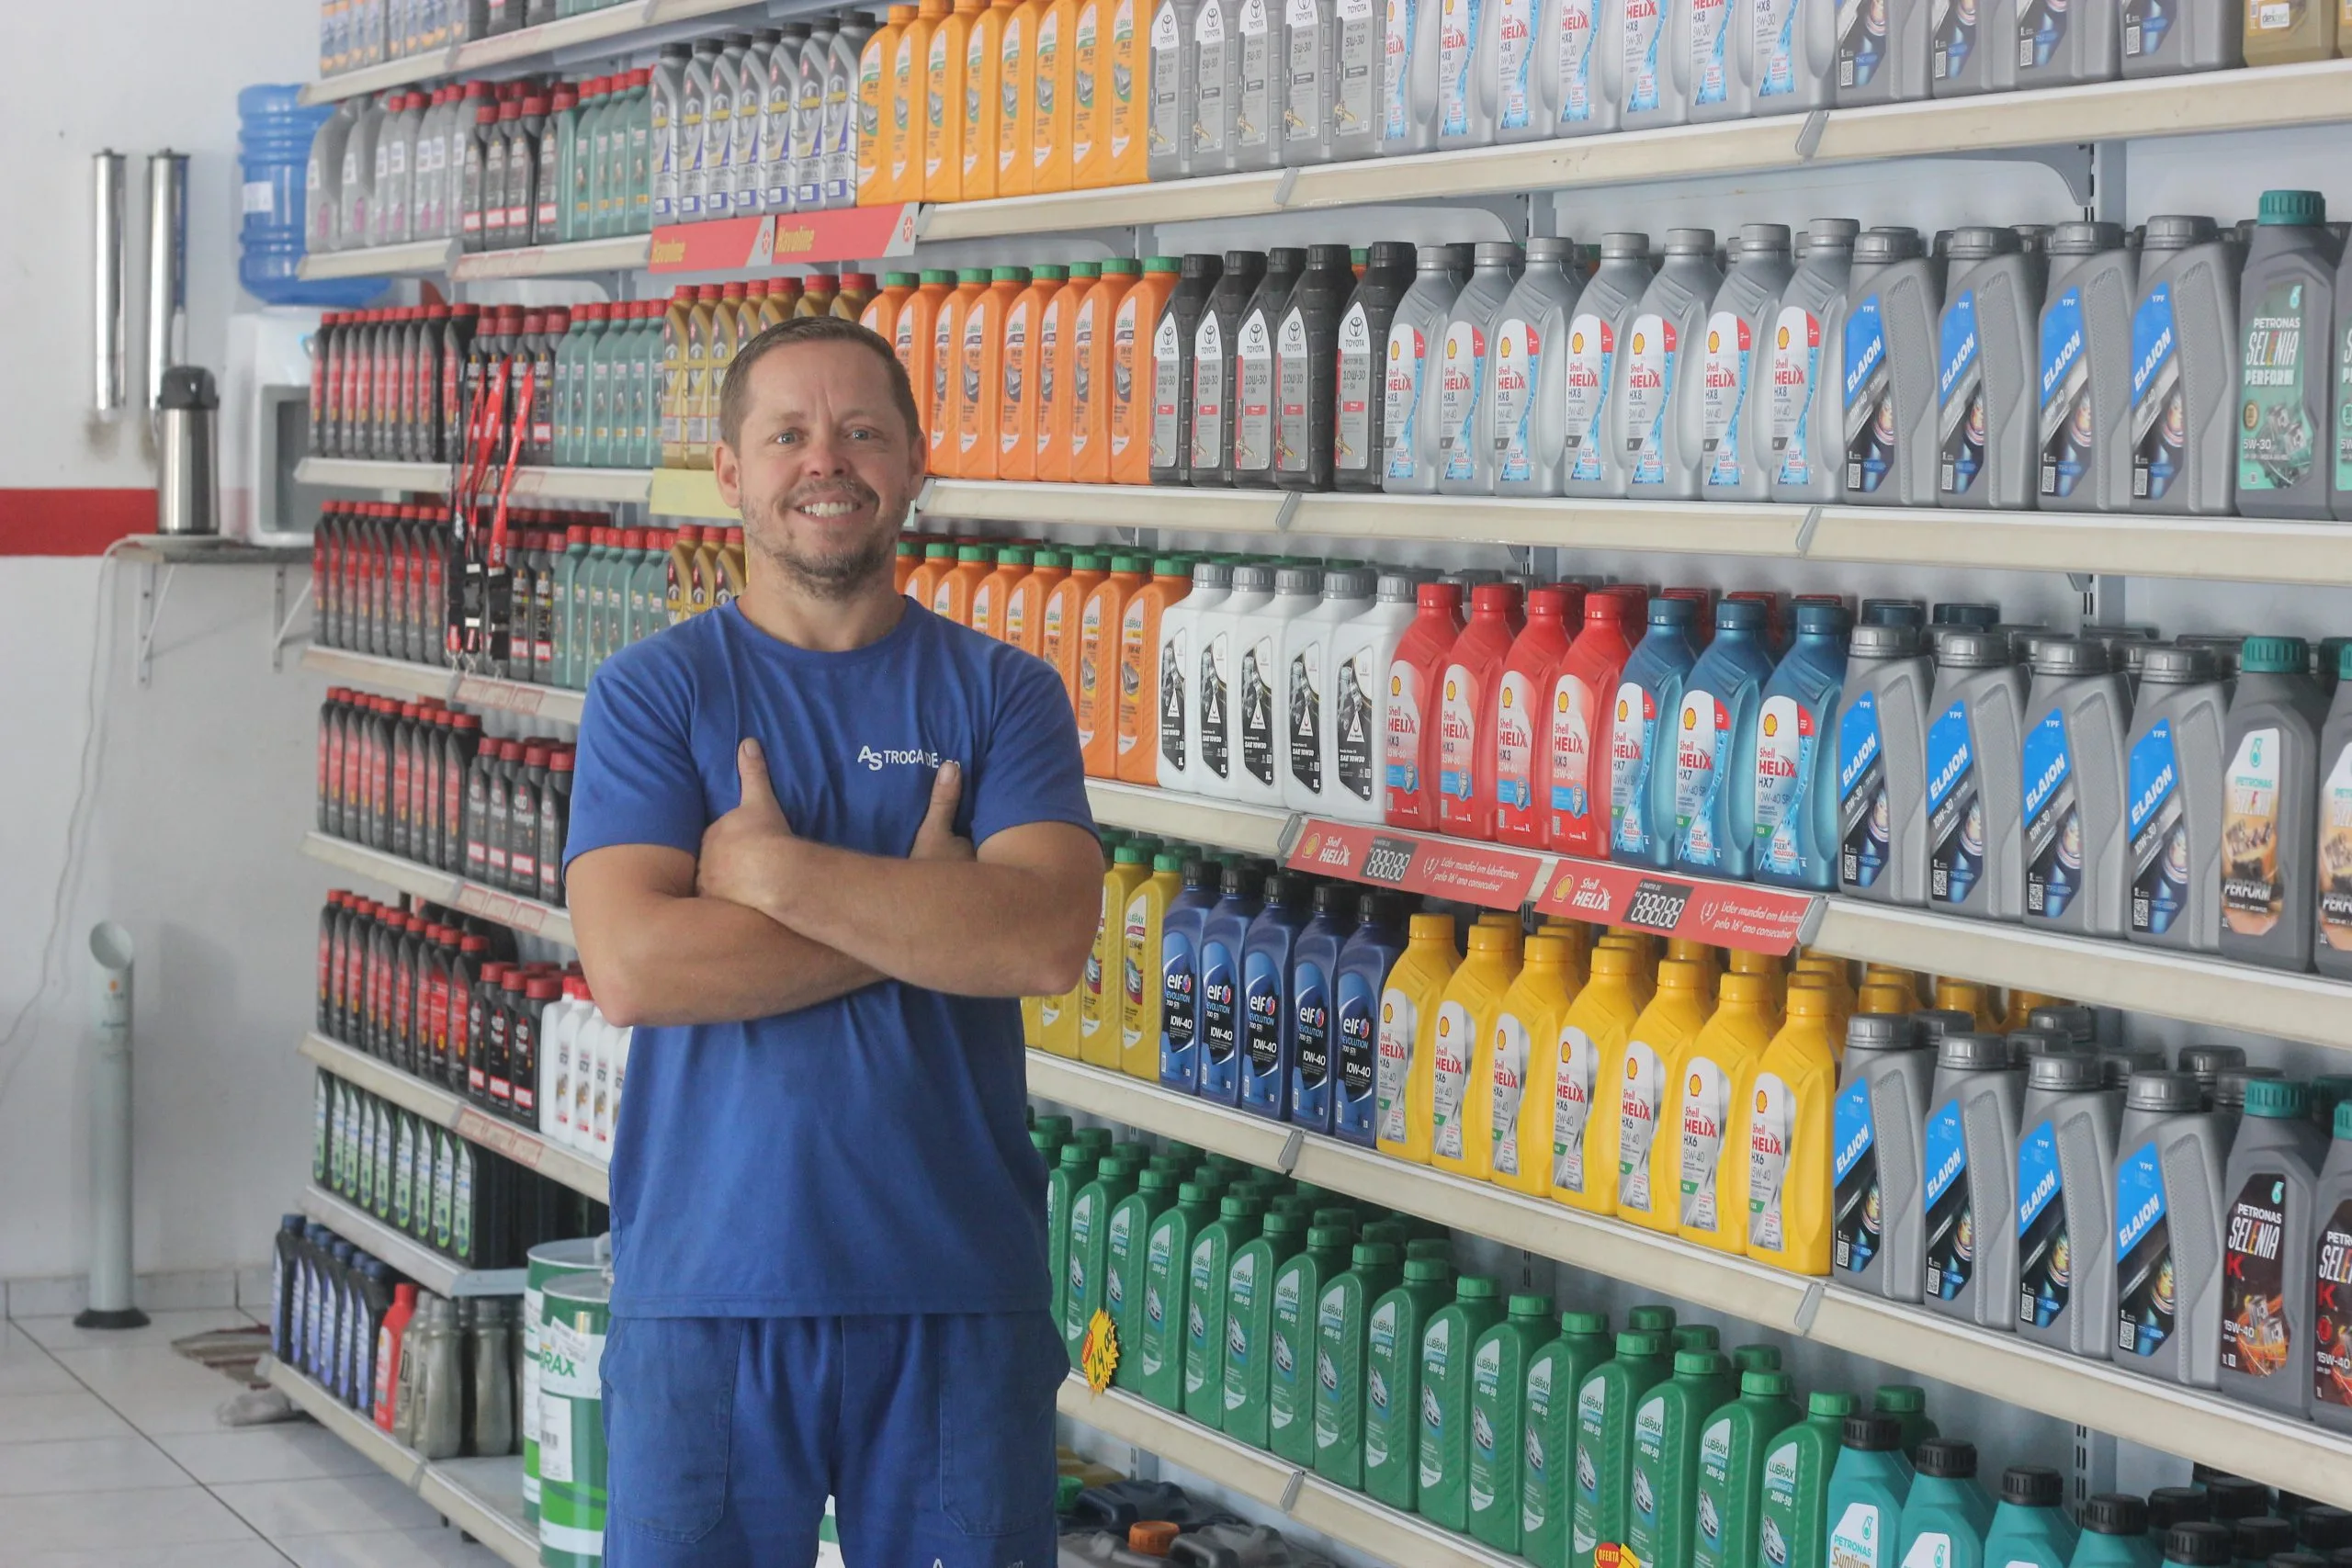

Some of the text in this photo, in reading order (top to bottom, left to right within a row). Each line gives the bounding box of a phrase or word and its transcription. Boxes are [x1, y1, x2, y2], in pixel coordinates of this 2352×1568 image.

[1348, 5, 1366, 14] TOYOTA
[1626, 2, 1657, 19] HELIX
[1756, 0, 1770, 11] HX8
[1295, 12, 1313, 21] TOYOTA
[1562, 12, 1589, 30] HELIX
[1693, 13, 1705, 24] HX8
[1500, 21, 1528, 39] HELIX
[1626, 20, 1638, 30] HX8
[1346, 36, 1364, 47] 5W-30
[2254, 318, 2301, 328] PETRONAS
[2246, 331, 2300, 366] SELENIA
[1847, 335, 1882, 393] ELAION
[1941, 333, 1974, 392] ELAION
[2043, 331, 2081, 391] ELAION
[2133, 327, 2171, 390] ELAION
[1343, 370, 1365, 380] 10W-30
[1388, 375, 1412, 390] HELIX
[1444, 375, 1470, 390] HELIX
[1498, 374, 1525, 389] HELIX
[1569, 370, 1598, 387] HELIX
[1630, 371, 1661, 388] HELIX
[1706, 371, 1736, 387] HELIX
[1775, 367, 1804, 384] HELIX
[2245, 369, 2294, 386] PERFORM
[2243, 439, 2271, 450] 5W-30
[1388, 716, 1416, 734] HELIX
[1442, 720, 1469, 739] HELIX
[1387, 736, 1398, 747] HX3
[1499, 728, 1528, 748] HELIX
[1555, 734, 1584, 754] HELIX
[1680, 740, 1693, 751] Shell
[1442, 741, 1453, 752] HX3
[1614, 742, 1642, 760] HELIX
[1759, 747, 1775, 758] Shell
[884, 750, 923, 764] TROCA
[924, 752, 939, 768] DE
[1499, 750, 1510, 761] HX3
[1555, 755, 1567, 767] HX3
[1679, 751, 1713, 771] HELIX
[1842, 733, 1876, 787] ELAION
[1613, 760, 1624, 771] HX7
[1758, 758, 1797, 778] HELIX
[1929, 744, 1968, 801] ELAION
[1679, 770, 1692, 780] HX7
[1758, 777, 1774, 788] HX7
[2025, 753, 2065, 812] ELAION
[1363, 786, 1370, 795] 1L
[2132, 764, 2172, 826] ELAION
[1845, 786, 1863, 815] 10W-30
[1933, 801, 1953, 829] 10W-30
[2030, 809, 2050, 841] 10W-30
[1326, 837, 1342, 847] Shell
[1318, 847, 1351, 866] HELIX
[1434, 871, 1447, 882] pelo
[1454, 861, 1476, 872] mundial
[1487, 864, 1519, 879] lubrificantes
[1580, 878, 1600, 889] Shell
[2224, 883, 2271, 900] PERFORM
[1572, 888, 1611, 910] HELIX
[1722, 901, 1737, 913] Líder
[1738, 907, 1768, 918] mundial
[1779, 910, 1803, 923] lubrifica
[1713, 917, 1729, 931] pelo
[1742, 925, 1756, 933] ano
[1167, 975, 1182, 989] elf
[1166, 992, 1190, 1003] EVOLUTION
[1207, 985, 1222, 1000] elf
[1206, 1003, 1230, 1014] EVOLUTION
[1250, 996, 1265, 1011] elf
[1170, 1015, 1193, 1030] 10W-40
[1250, 1012, 1274, 1025] EVOLUTION
[1300, 1007, 1315, 1023] elf
[1210, 1026, 1232, 1041] 10W-40
[1299, 1024, 1323, 1038] EVOLUTION
[1343, 1018, 1360, 1034] elf
[1253, 1038, 1276, 1053] 10W-40
[1342, 1035, 1368, 1049] EVOLUTION
[1303, 1050, 1326, 1066] 10W-40
[1380, 1043, 1405, 1059] HELIX
[1346, 1062, 1371, 1077] 10W-40
[1435, 1056, 1463, 1074] HELIX
[1494, 1071, 1518, 1089] HELIX
[1556, 1084, 1585, 1102] HELIX
[1556, 1100, 1567, 1111] HX6
[1623, 1100, 1651, 1121] HELIX
[1685, 1106, 1699, 1117] Shell
[1622, 1118, 1633, 1129] HX6
[1684, 1118, 1717, 1137] HELIX
[1753, 1123, 1765, 1134] Shell
[1684, 1135, 1697, 1146] HX6
[1752, 1134, 1782, 1156] HELIX
[1837, 1124, 1869, 1174] ELAION
[1752, 1152, 1764, 1165] HX6
[1928, 1148, 1961, 1198] ELAION
[2021, 1170, 2055, 1224] ELAION
[2120, 1194, 2159, 1247] ELAION
[2238, 1203, 2282, 1224] PETRONAS
[2228, 1217, 2280, 1260] SELENIA
[1233, 1271, 1252, 1284] LUBRAX
[1278, 1286, 1297, 1301] LUBRAX
[1322, 1303, 1342, 1317] LUBRAX
[1373, 1319, 1394, 1334] LUBRAX
[2224, 1319, 2254, 1337] 15W-40
[1427, 1337, 1446, 1352] LUBRAX
[1476, 1357, 1498, 1371] LUBRAX
[2317, 1350, 2350, 1369] 15W-40
[1530, 1375, 1549, 1392] LUBRAX
[1581, 1393, 1603, 1410] LUBRAX
[1638, 1416, 1661, 1432] LUBRAX
[1704, 1438, 1727, 1455] LUBRAX
[1769, 1461, 1794, 1478] LUBRAX
[1834, 1535, 1872, 1558] PETRONAS
[1599, 1550, 1620, 1563] OFERTA
